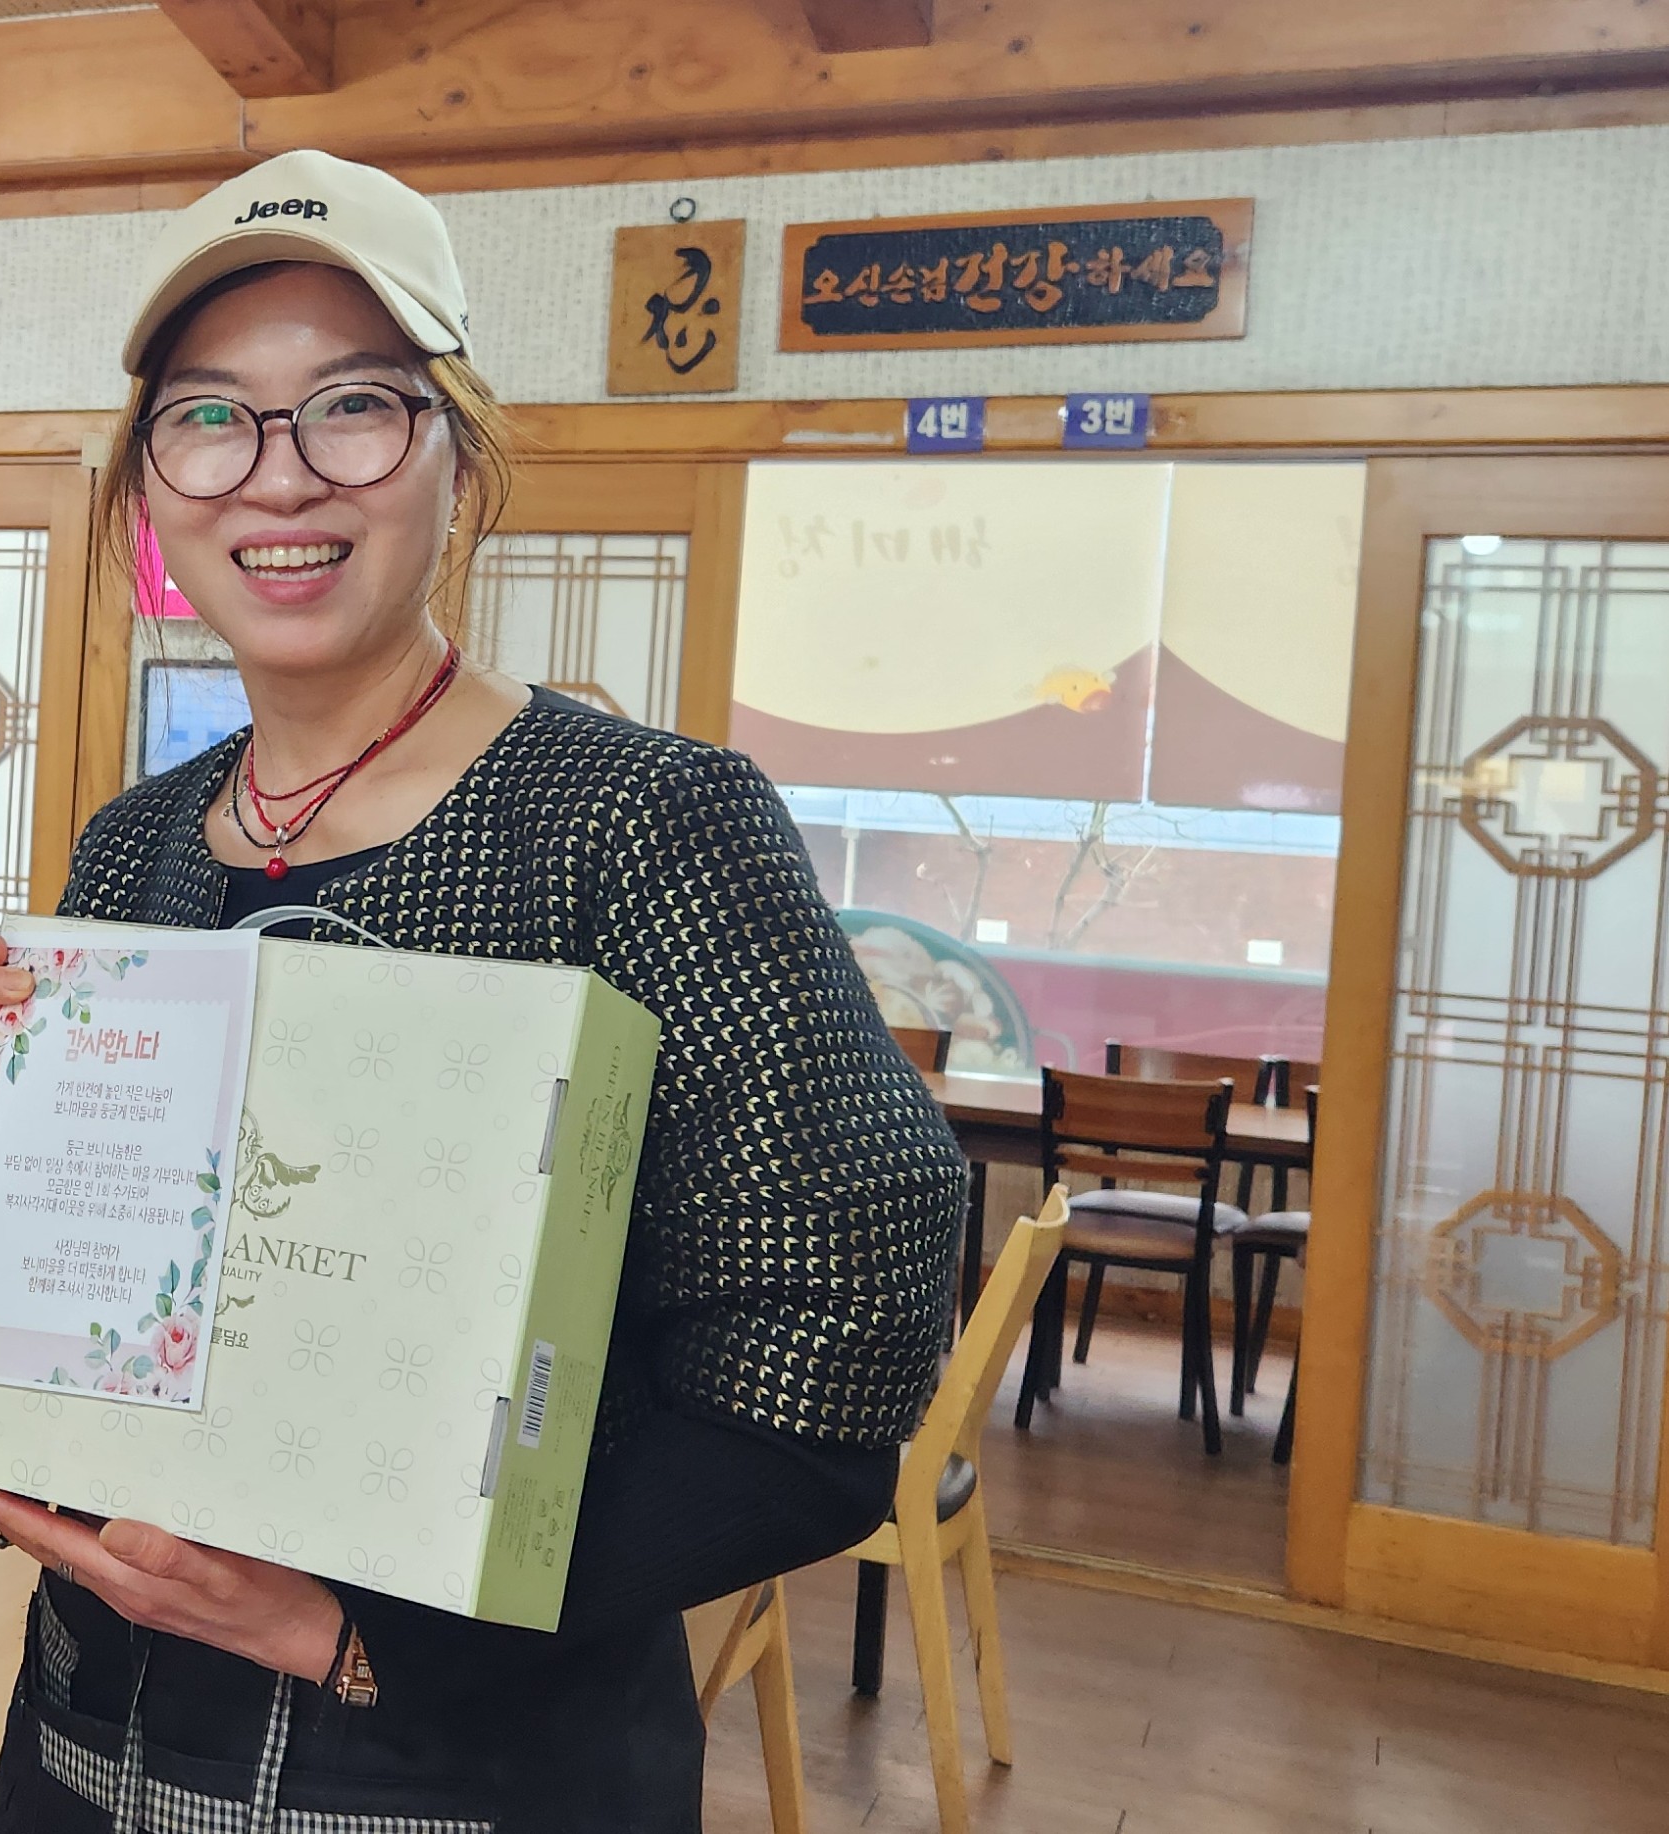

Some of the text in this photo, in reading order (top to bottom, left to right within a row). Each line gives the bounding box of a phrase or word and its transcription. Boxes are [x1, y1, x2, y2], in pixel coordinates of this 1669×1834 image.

[235, 198, 328, 224] Jeep
[952, 241, 1080, 313] 건강
[1085, 245, 1215, 295] 하세요
[917, 402, 969, 439] 4번
[1080, 399, 1135, 435] 3번
[65, 1028, 160, 1064] 감사합니다
[56, 1080, 74, 1096] 가게
[106, 1083, 123, 1100] 놓인
[125, 1085, 143, 1102] 작은
[145, 1086, 173, 1104] 나눔이
[54, 1101, 98, 1119] 보니마을을
[100, 1103, 128, 1120] 둥글게
[66, 1140, 143, 1161] 둥근 보니 나눔함은
[4, 1154, 22, 1171] 부담
[46, 1156, 64, 1175] 일상
[67, 1159, 92, 1177] 속에서
[95, 1161, 130, 1181] 참여하는
[132, 1164, 150, 1183] 마을
[46, 1178, 149, 1202] 모금함은 연 1회 수거되어
[5, 1193, 58, 1213] 복지사각지대
[59, 1198, 85, 1217] 이웃을
[108, 1203, 136, 1221] 소중히
[55, 1239, 120, 1261] 사장님의 참여가
[223, 1226, 367, 1282] ANKET
[21, 1256, 66, 1275] 보니마을을
[68, 1261, 78, 1278] 더
[80, 1262, 116, 1281] 따뜻하게
[220, 1265, 262, 1283] UALITY
[28, 1276, 55, 1294] 함께해
[57, 1280, 84, 1299] 주셔서
